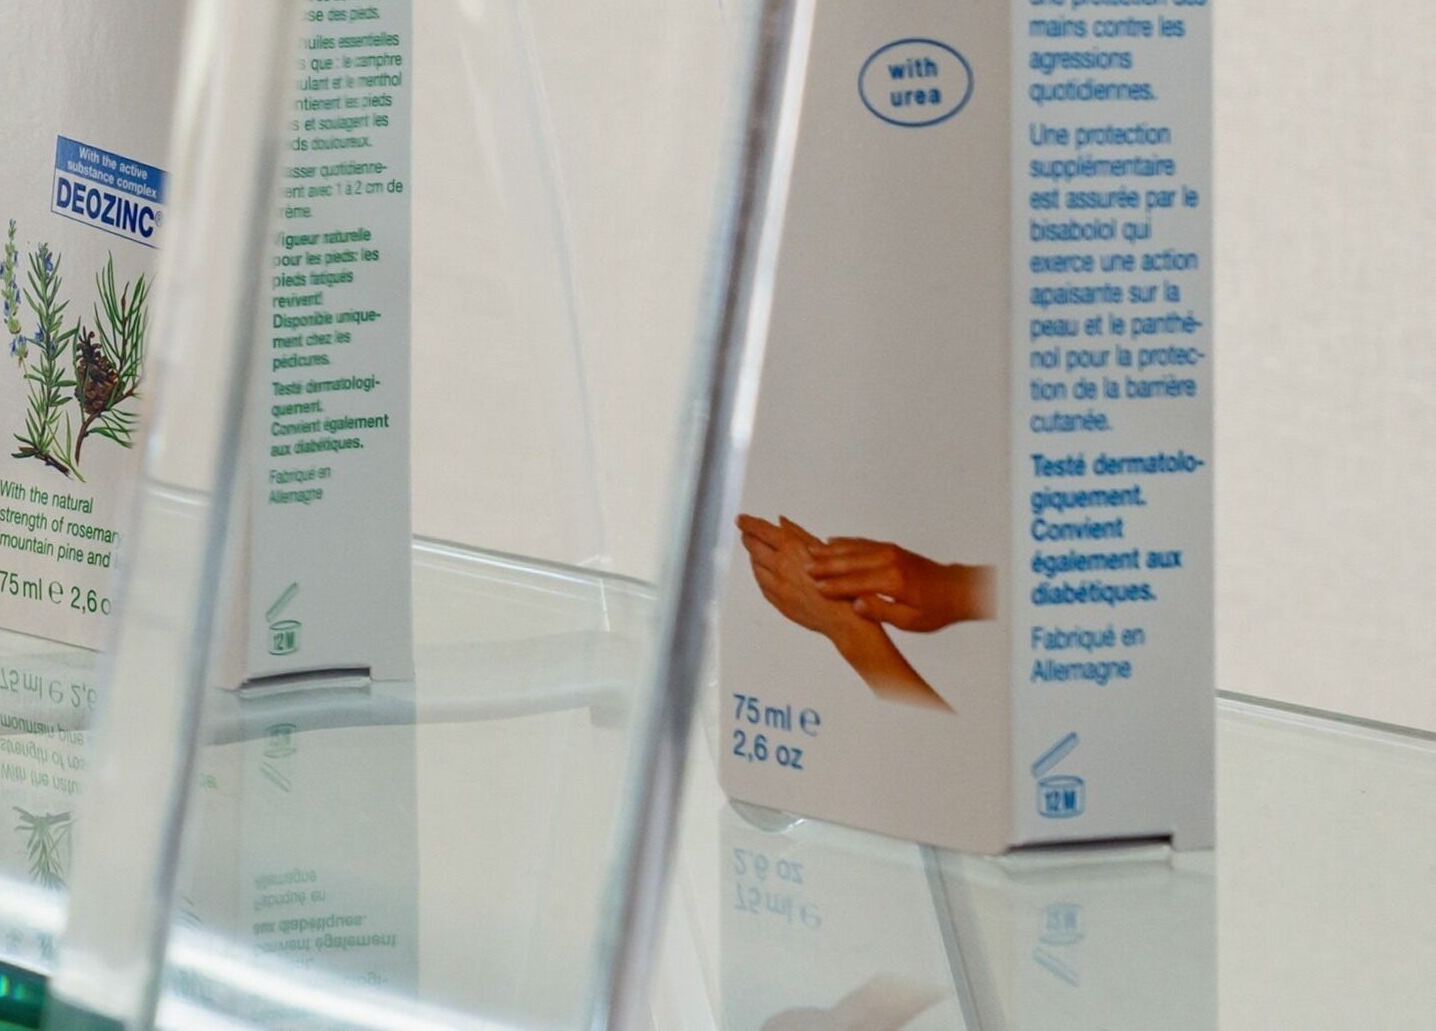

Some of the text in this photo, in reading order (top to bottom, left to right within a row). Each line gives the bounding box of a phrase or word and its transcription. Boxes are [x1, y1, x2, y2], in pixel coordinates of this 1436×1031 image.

[887, 57, 938, 80] with
[889, 87, 941, 108] urea
[78, 146, 148, 180] With the active
[67, 160, 157, 199] substance complex
[1030, 188, 1059, 211] est
[1145, 190, 1175, 213] par
[1182, 186, 1198, 208] le
[324, 414, 390, 434] également
[270, 445, 291, 457] aux
[0, 480, 94, 514] With the natural
[0, 507, 47, 532] strength
[51, 516, 64, 533] of
[1030, 517, 1122, 542] Convient
[0, 533, 111, 568] mountain pine and
[1145, 550, 1182, 570] aux
[70, 586, 97, 614] 2,6
[1121, 627, 1145, 648] en
[1030, 658, 1130, 685] Allemagne
[733, 693, 760, 725] 75
[765, 704, 792, 732] ml
[733, 729, 803, 770] 2,6 oz
